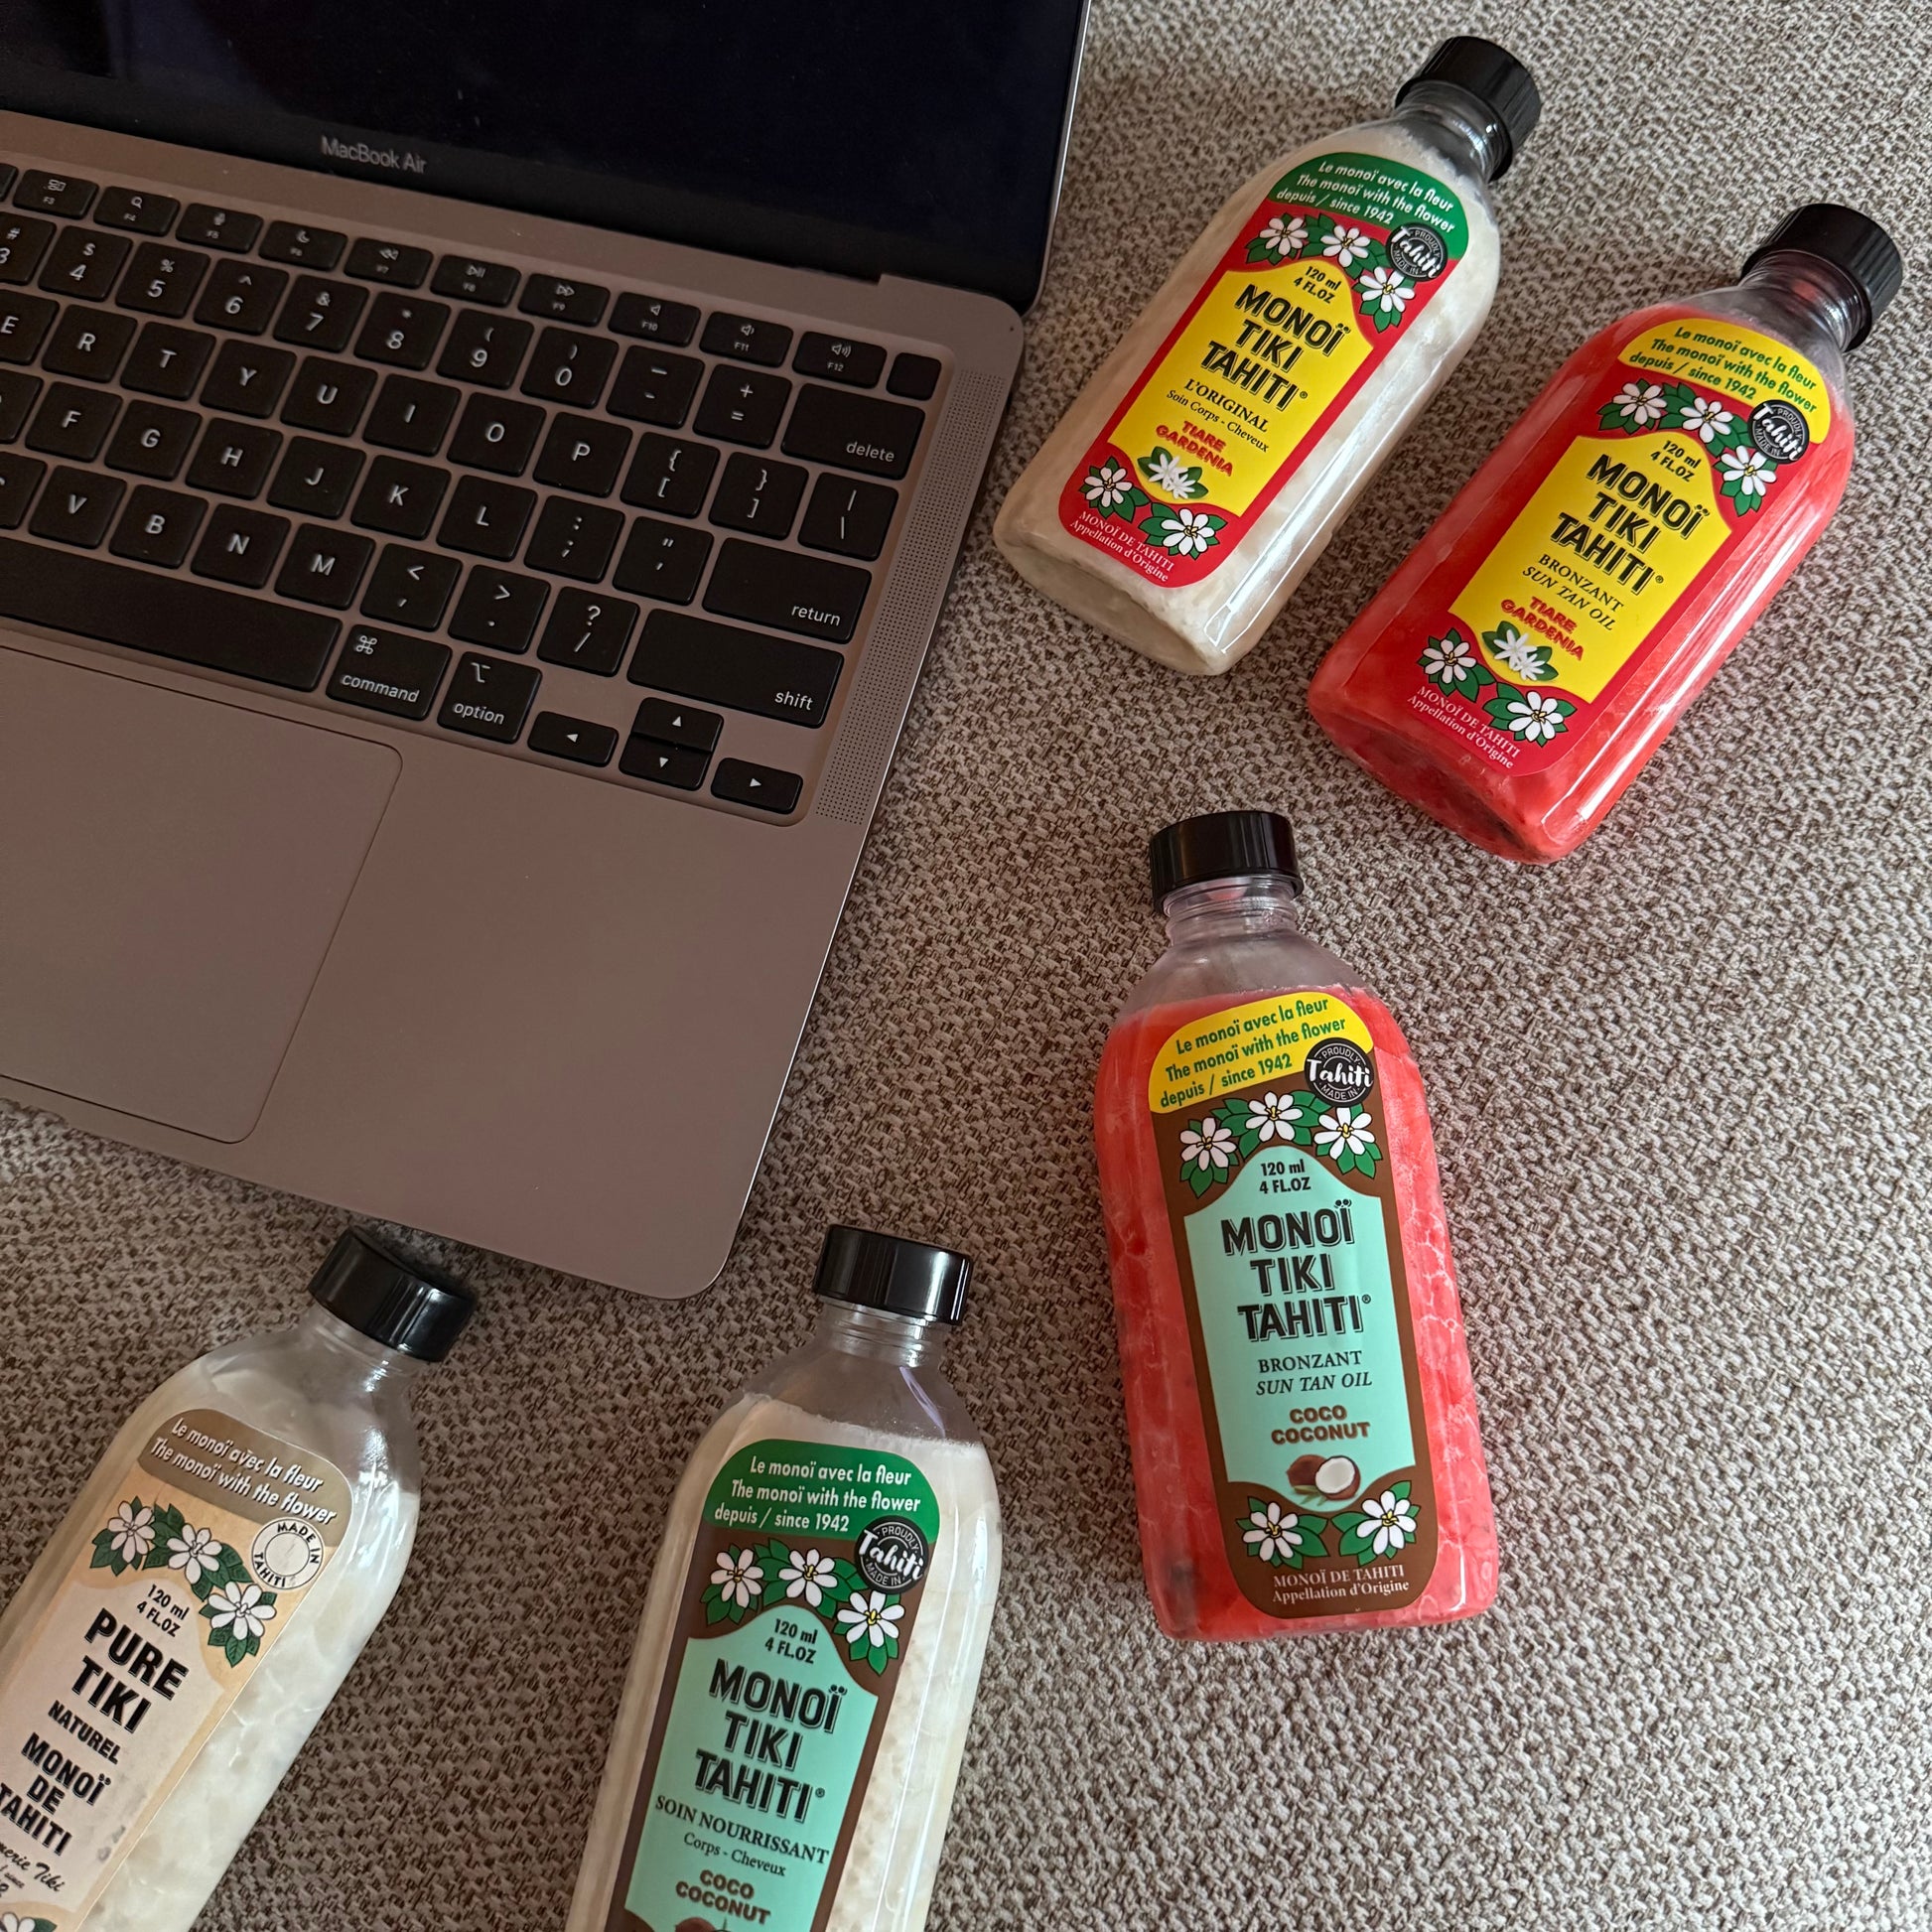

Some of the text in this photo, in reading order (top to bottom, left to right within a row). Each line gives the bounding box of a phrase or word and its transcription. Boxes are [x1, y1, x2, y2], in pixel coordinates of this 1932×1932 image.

[321, 136, 427, 174] MacBook Air
[1277, 189, 1394, 224] depuis since 1942
[1297, 175, 1454, 233] The monoï with the flower
[1318, 161, 1453, 212] Le monoï avec la fleur
[1391, 225, 1441, 279] Tahiti
[1306, 266, 1342, 291] 120 ml
[1234, 283, 1350, 357] MONOÏ
[1236, 320, 1304, 373] TIKI
[1674, 327, 1817, 390] Le monoï avec la fleur
[1629, 352, 1757, 400] depuis since 1942
[1651, 339, 1818, 414] The monoï with the flower
[1167, 389, 1270, 453] Soin Corps Cheveux
[1181, 420, 1226, 453] TIARE
[1753, 402, 1803, 461] Tahiti
[846, 441, 895, 463] delete
[1156, 425, 1233, 477] GARDENIA
[1663, 440, 1701, 469] 120 ml
[1586, 454, 1710, 539] MONOÏ
[1069, 519, 1126, 554] Appellation
[1079, 510, 1174, 572] MONOÏ DE TAHITI
[1588, 491, 1661, 554] TIKI
[1523, 566, 1615, 630] SUN TAN OIL
[1538, 554, 1624, 612] BRONZANT
[791, 604, 841, 625] return
[1501, 599, 1585, 660] GARDENIA
[1529, 596, 1578, 634] TIARE
[342, 672, 420, 703] command
[775, 690, 813, 711] shift
[454, 700, 505, 725] option
[1407, 695, 1466, 734] Appellation
[1417, 686, 1520, 759] MONOÏ DE TAHITI
[1176, 998, 1328, 1054] Le monoï avec la fleur
[1166, 1018, 1345, 1083] The monoï with the flower
[1321, 1046, 1360, 1063] PROUDLY
[1160, 1053, 1292, 1109] depuis since 1942
[1307, 1058, 1373, 1088] Tahiti
[1260, 1159, 1305, 1176] 120 ml
[1273, 1177, 1311, 1192] FL.OZ
[1221, 1198, 1354, 1256] MONOÏ
[1250, 1254, 1334, 1297] TIKI
[1259, 1350, 1362, 1373] BRONZANT
[1256, 1371, 1372, 1395] SUN TAN OIL
[1271, 1422, 1370, 1445] COCONUT
[1289, 1405, 1347, 1424] COCO
[172, 1418, 324, 1492] Le monoï avec la fleur
[751, 1455, 911, 1486] Le monoï avec la fleur
[151, 1437, 337, 1525] The monoï with the flower
[732, 1479, 920, 1512] The monoï with the flower
[277, 1522, 316, 1543] MADE
[715, 1502, 850, 1532] depuis since 1942
[859, 1529, 923, 1581] Tahiti
[882, 1527, 919, 1550] PROUDLY
[253, 1552, 287, 1587] TAHITI
[1274, 1564, 1405, 1588] MONOÏ DE TAHITI
[148, 1585, 190, 1620] 120 ml
[1272, 1587, 1347, 1604] Appellation
[774, 1618, 818, 1644] 120 ml
[84, 1607, 190, 1701] PURE
[777, 1641, 816, 1664] FL.OZ
[71, 1655, 152, 1734] TIKI
[709, 1658, 847, 1733] MONOÏ
[48, 1700, 121, 1765] NATUREL
[724, 1711, 803, 1771] TIKI
[21, 1732, 111, 1806] MONOÏ
[27, 1774, 66, 1816] DE
[655, 1796, 829, 1864] SOIN NOURRISSANT
[684, 1833, 786, 1876] Corps Cheveux
[34, 1863, 65, 1891] Tiki
[699, 1869, 755, 1900] COCO
[676, 1881, 770, 1925] COCONUT
